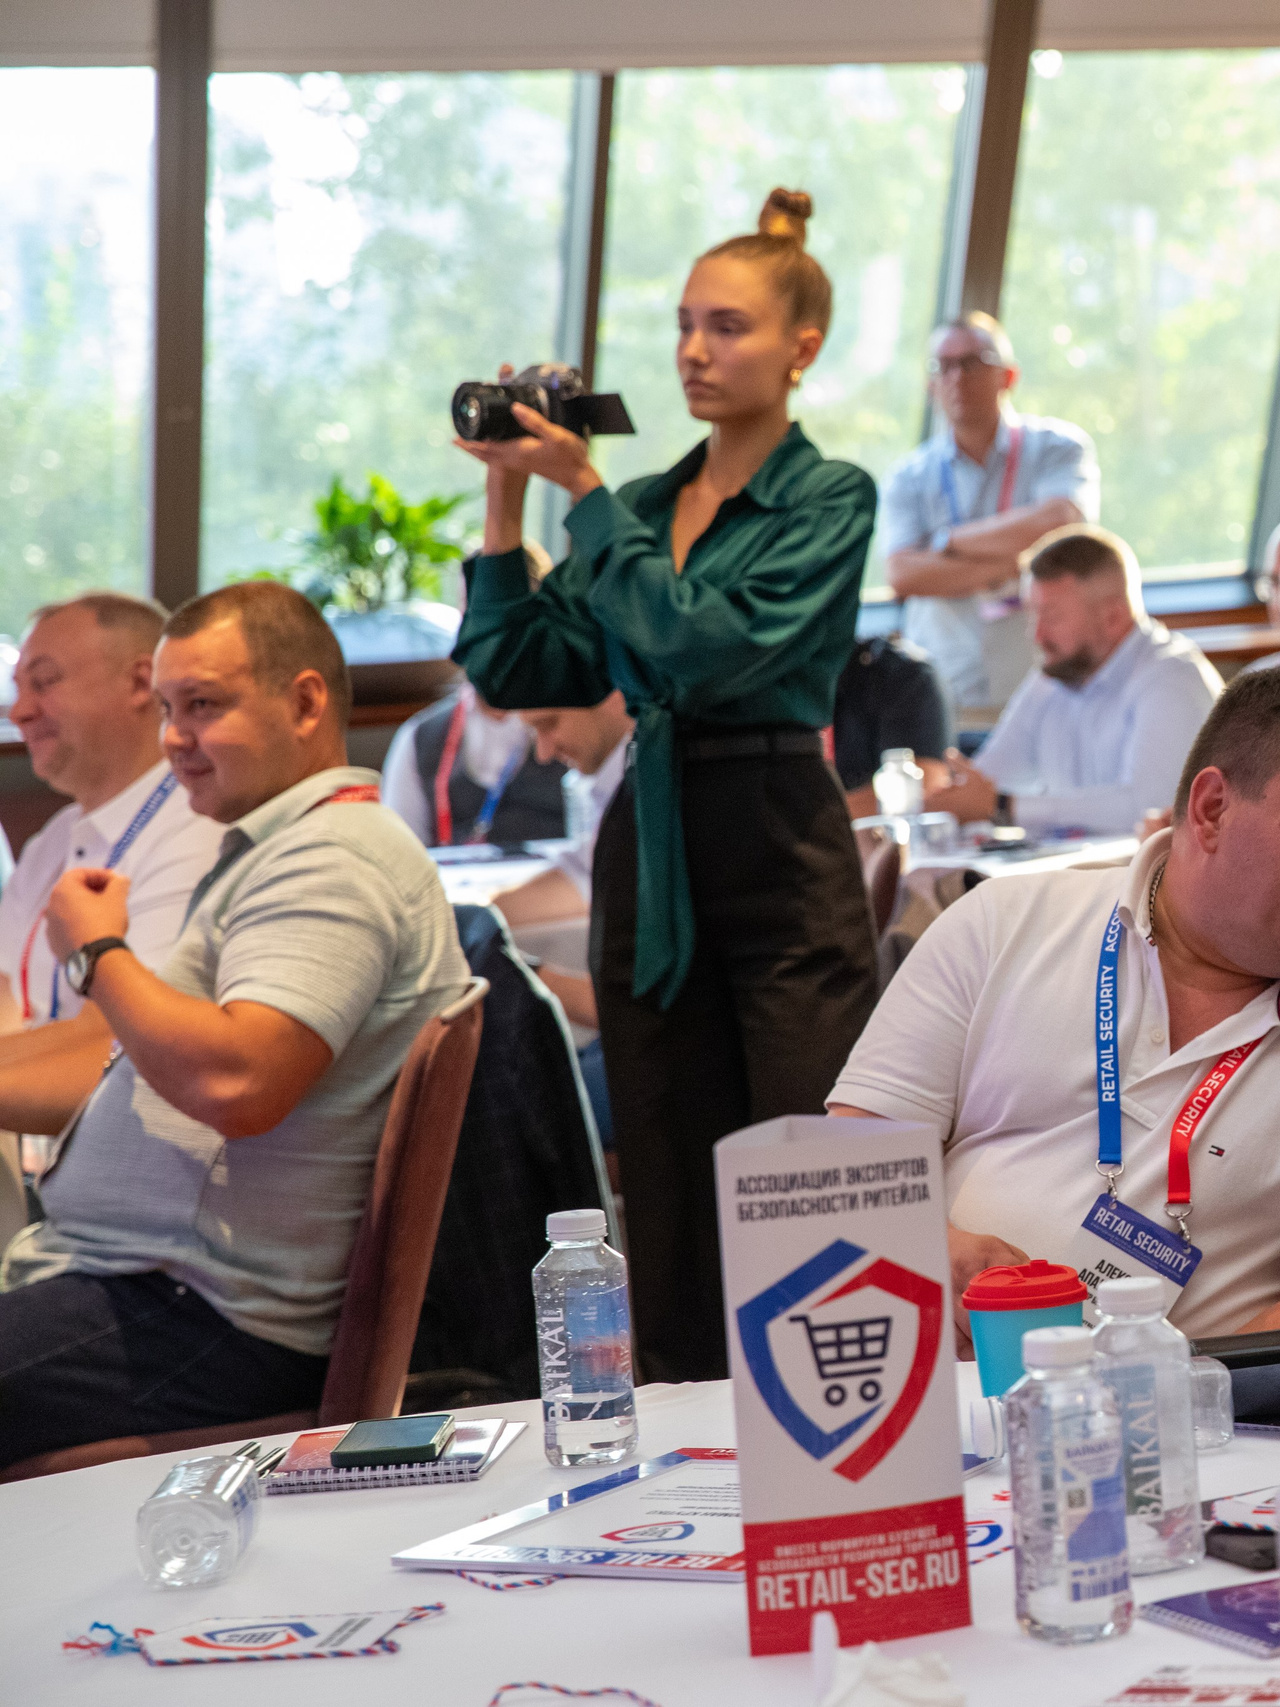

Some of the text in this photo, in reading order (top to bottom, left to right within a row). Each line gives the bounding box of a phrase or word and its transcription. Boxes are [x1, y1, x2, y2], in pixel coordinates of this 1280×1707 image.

[1099, 965, 1116, 1102] RETAIL SECURITY
[1176, 1071, 1226, 1138] SECURITY
[736, 1157, 929, 1196] АССОЦИАЦИЯ ЭКСПЕРТОВ
[737, 1182, 931, 1222] БЕЗОПАСНОСТИ РИТЕЙЛА
[1094, 1207, 1132, 1241] RETAIL
[1134, 1231, 1191, 1272] SECURITY
[604, 1554, 723, 1569] RETAIL
[756, 1550, 961, 1612] RETAIL-SEC.RU
